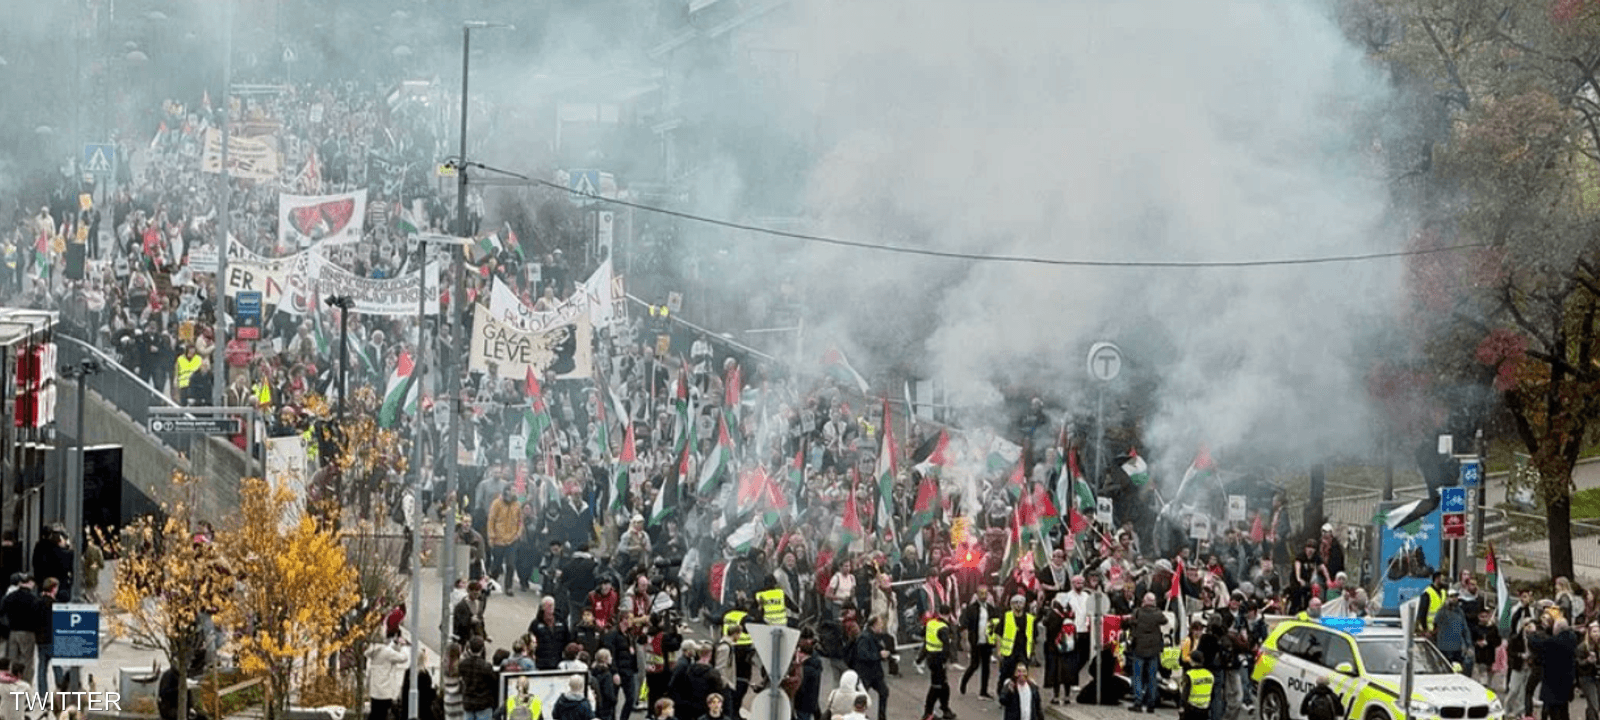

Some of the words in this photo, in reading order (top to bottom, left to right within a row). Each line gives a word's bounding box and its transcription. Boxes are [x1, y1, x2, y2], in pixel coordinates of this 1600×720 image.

[229, 267, 254, 290] ER
[483, 323, 531, 346] GAZA
[483, 339, 531, 364] LEVE
[1098, 355, 1117, 378] T
[70, 614, 82, 628] P
